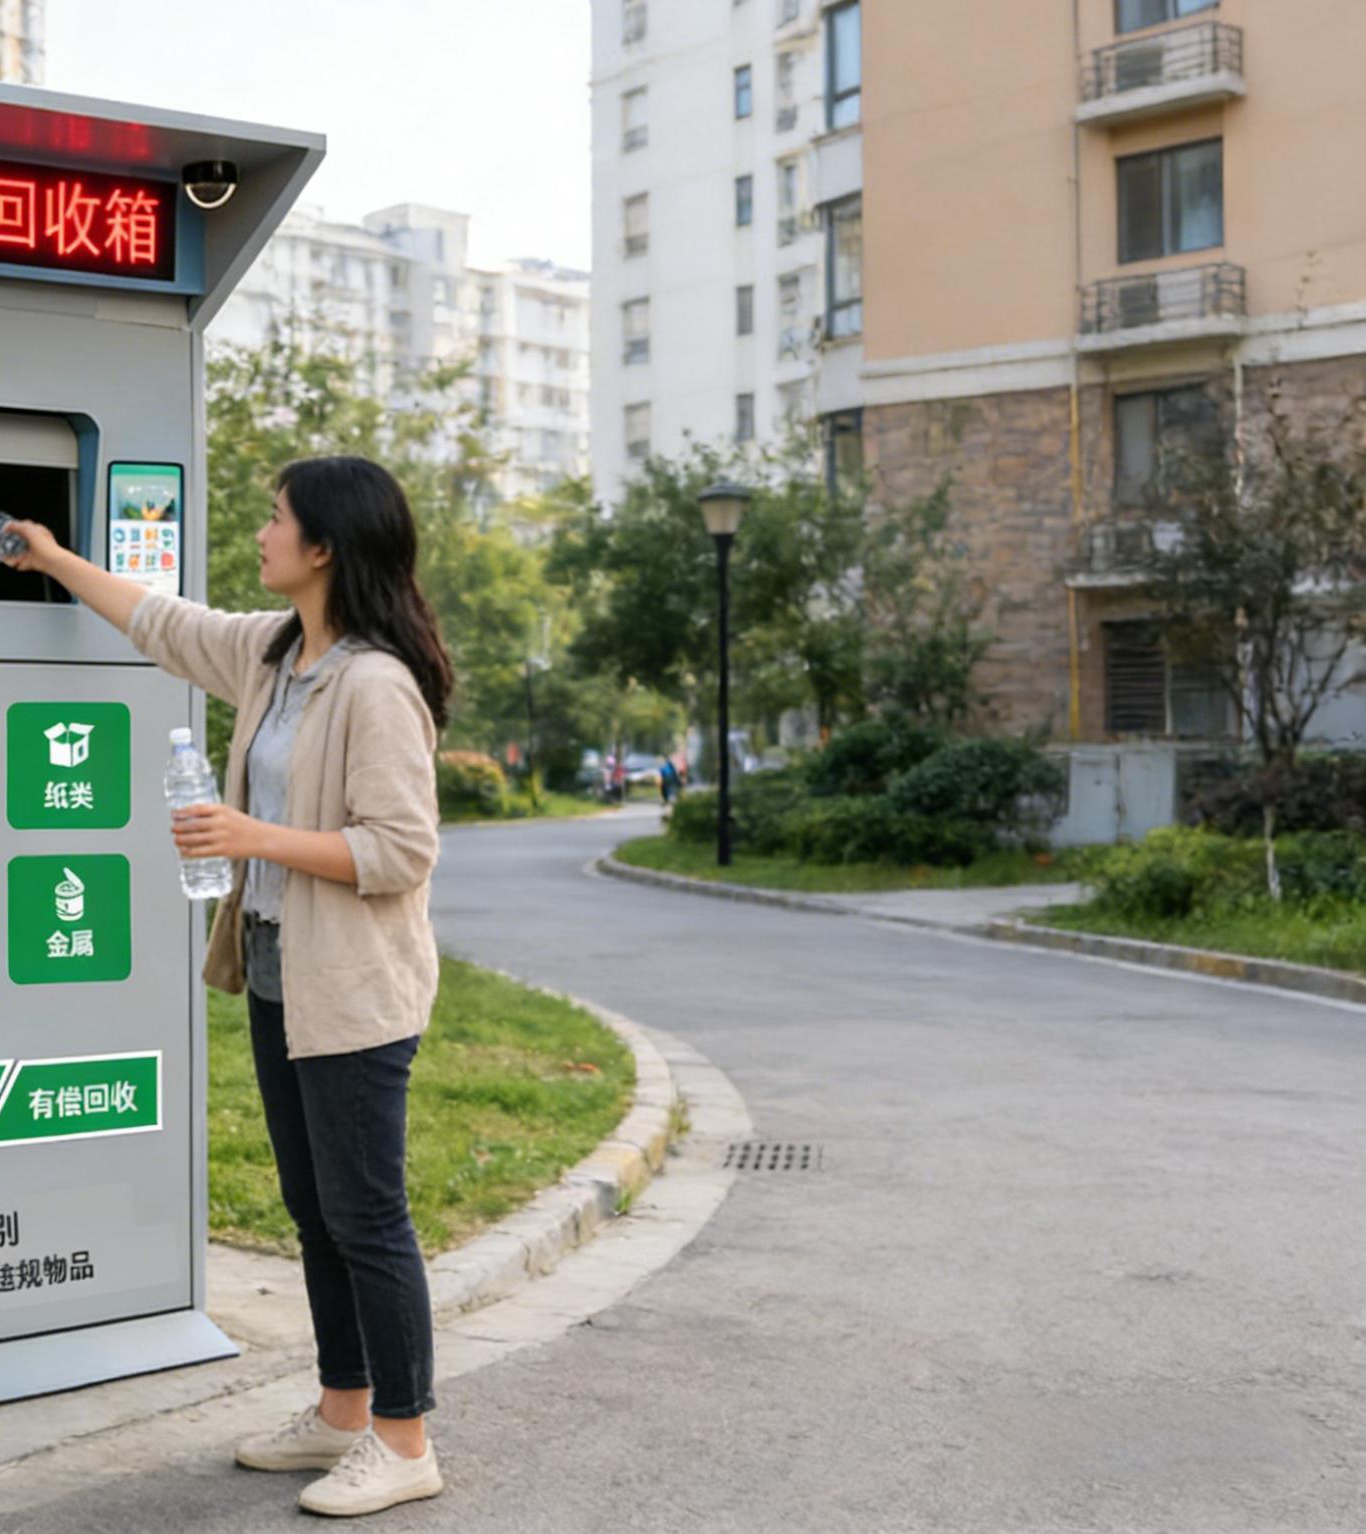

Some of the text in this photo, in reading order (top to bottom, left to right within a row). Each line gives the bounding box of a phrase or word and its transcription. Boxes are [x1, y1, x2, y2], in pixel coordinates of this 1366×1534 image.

[44, 781, 94, 809] 纸类
[46, 929, 94, 958] 金属
[28, 1080, 138, 1121] 有偿回收
